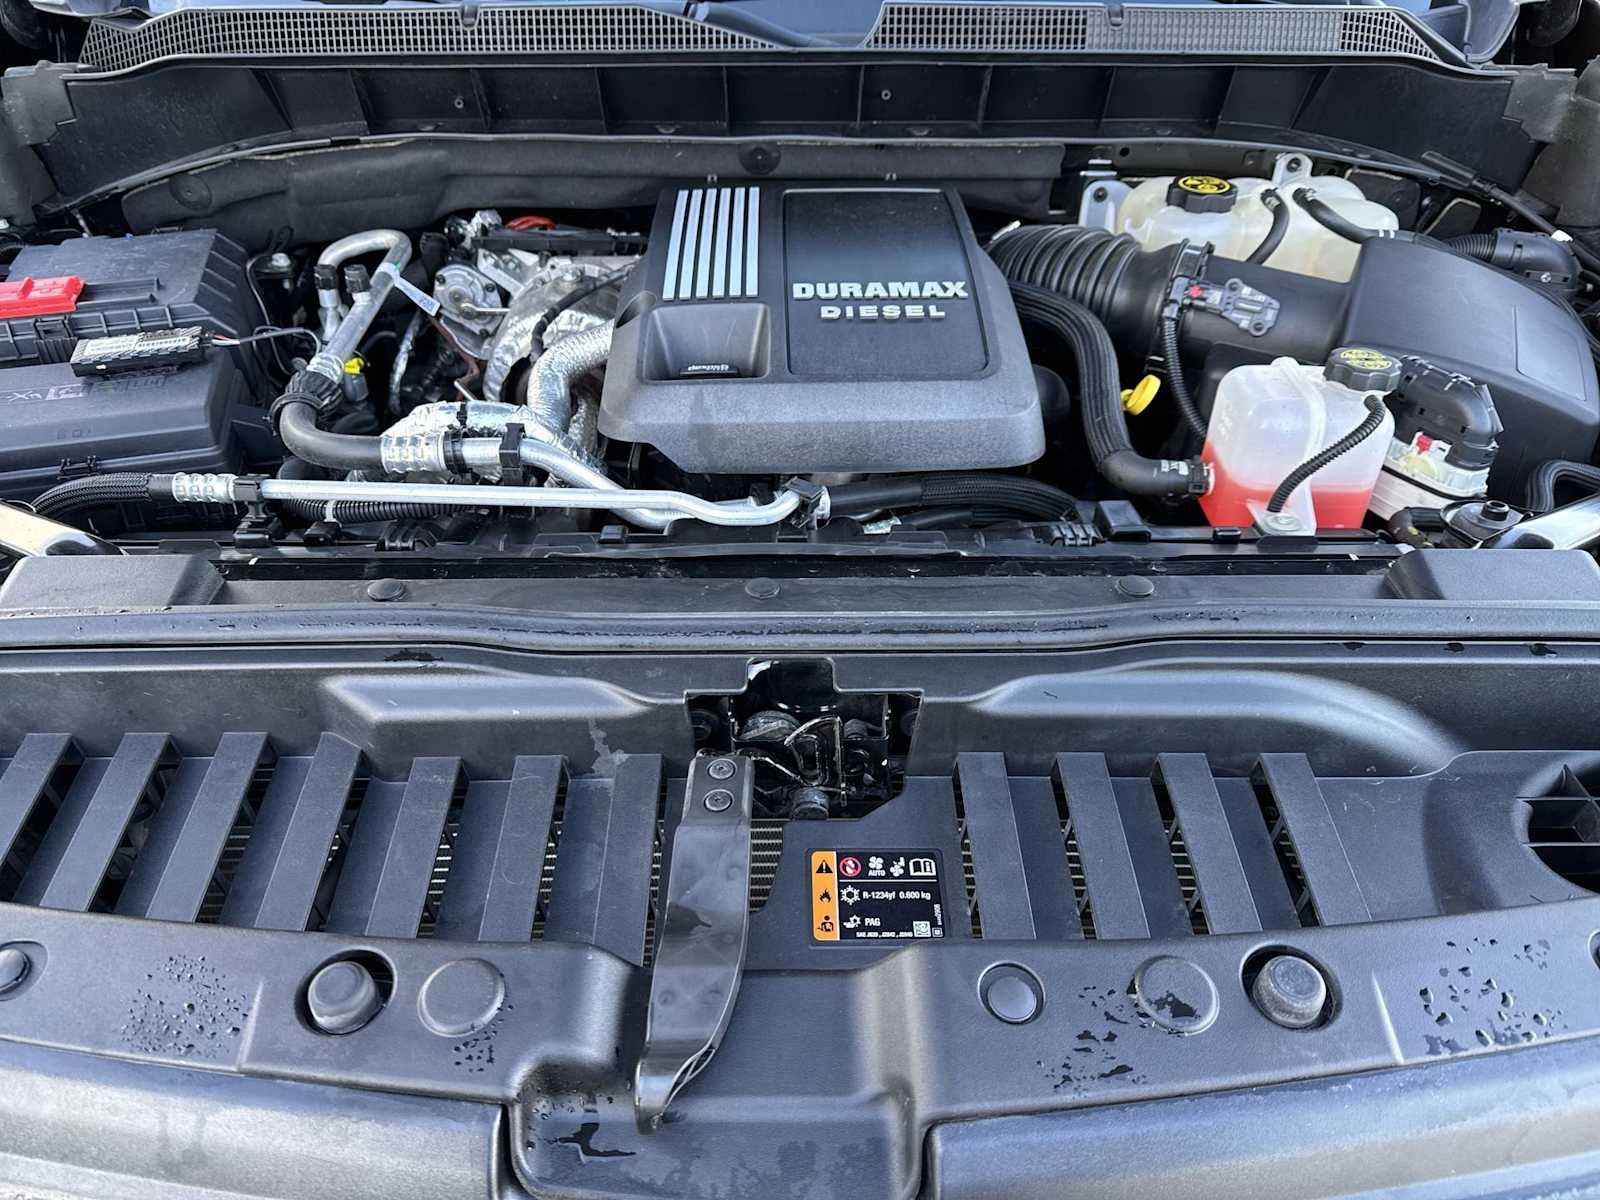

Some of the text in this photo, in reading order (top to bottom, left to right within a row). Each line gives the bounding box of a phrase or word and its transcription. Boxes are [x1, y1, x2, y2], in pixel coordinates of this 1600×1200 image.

[792, 281, 969, 300] DURAMAX
[820, 304, 946, 320] DIESEL
[868, 869, 886, 877] AUTO
[862, 890, 896, 901] R-1234yf
[921, 890, 931, 901] kg
[864, 917, 881, 927] PAG
